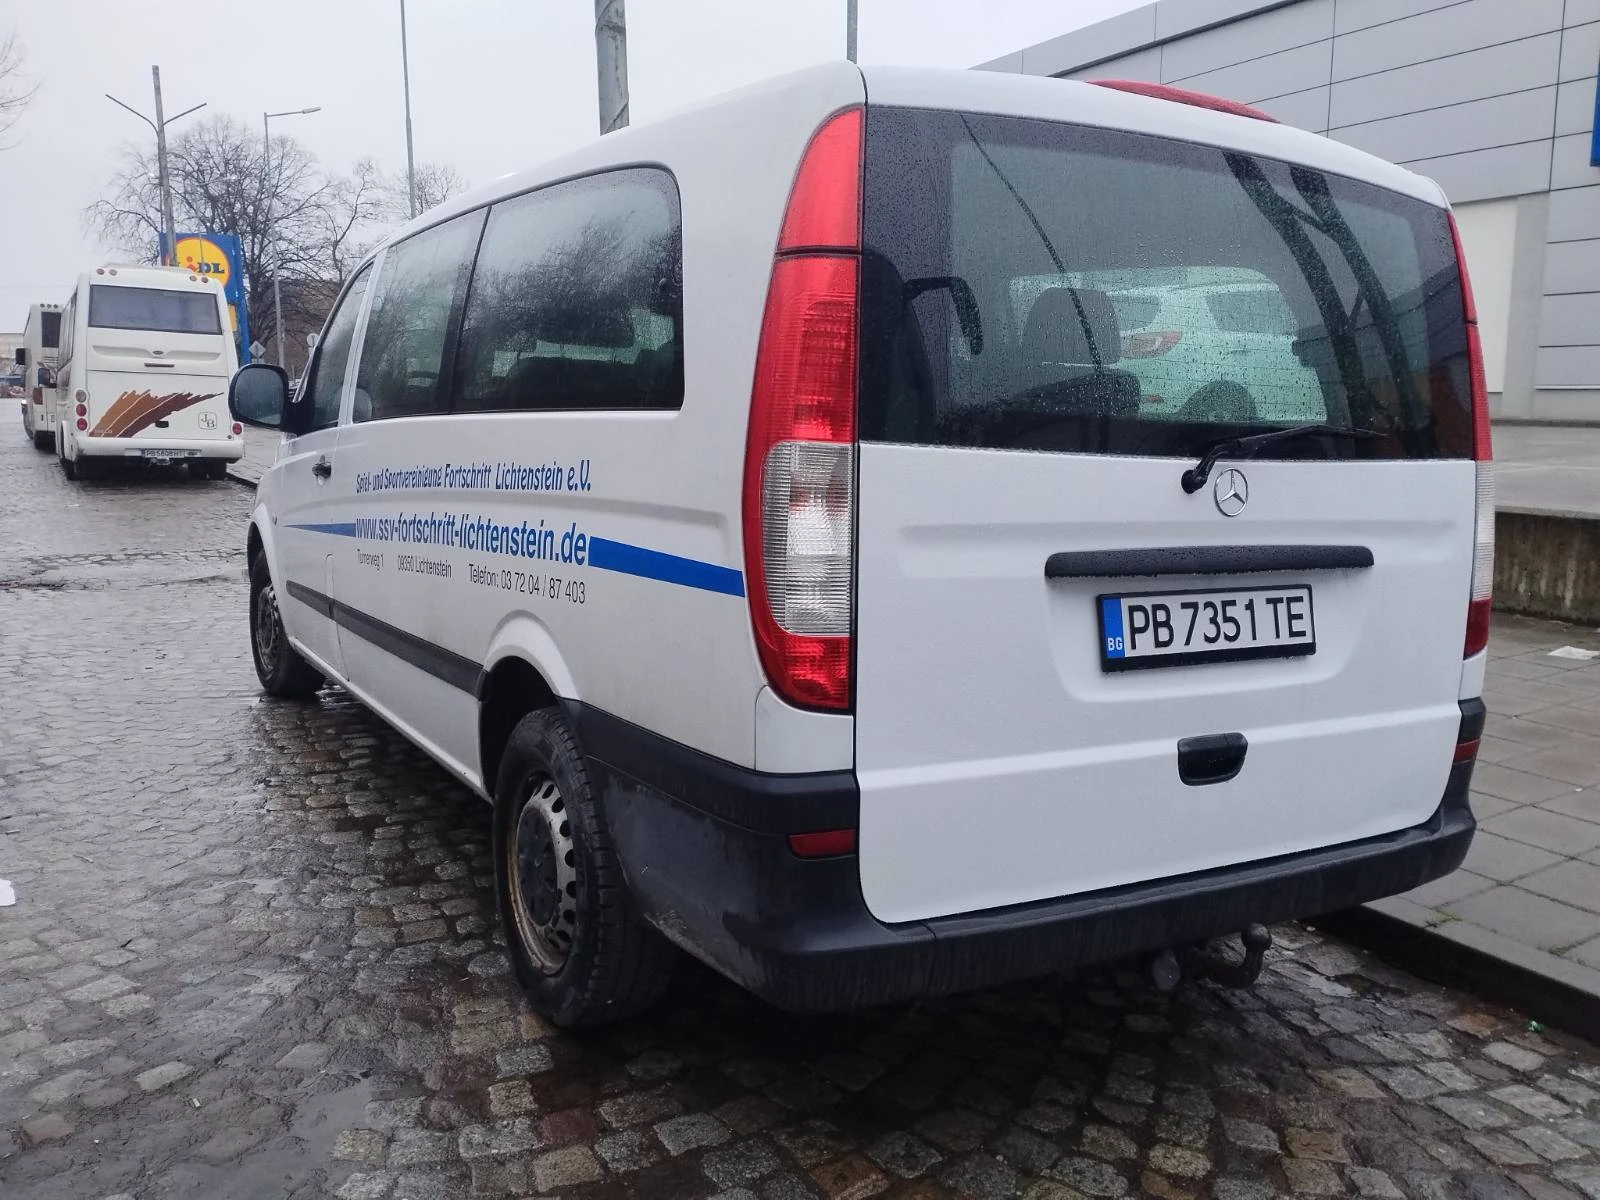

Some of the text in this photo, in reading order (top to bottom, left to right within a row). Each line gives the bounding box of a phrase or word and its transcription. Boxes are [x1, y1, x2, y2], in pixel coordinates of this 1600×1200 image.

[372, 469, 383, 491] und
[384, 465, 442, 489] Sportvereinigung
[444, 462, 492, 489] Fortschritt
[495, 461, 563, 490] Lichtenstein
[567, 459, 591, 492] e.V.
[356, 512, 587, 566] www.ssv-fortschritt-lichtenstein.de
[380, 554, 384, 568] 1
[415, 555, 452, 578] Lichtenstein
[469, 563, 499, 588] Telefon:
[501, 569, 512, 591] 03
[515, 572, 526, 593] 72
[528, 574, 540, 596] 04
[542, 575, 547, 597] /
[549, 577, 562, 600] 87
[565, 580, 586, 605] 403
[1107, 637, 1123, 652] BG
[1128, 596, 1307, 650] PB 7351 TE
